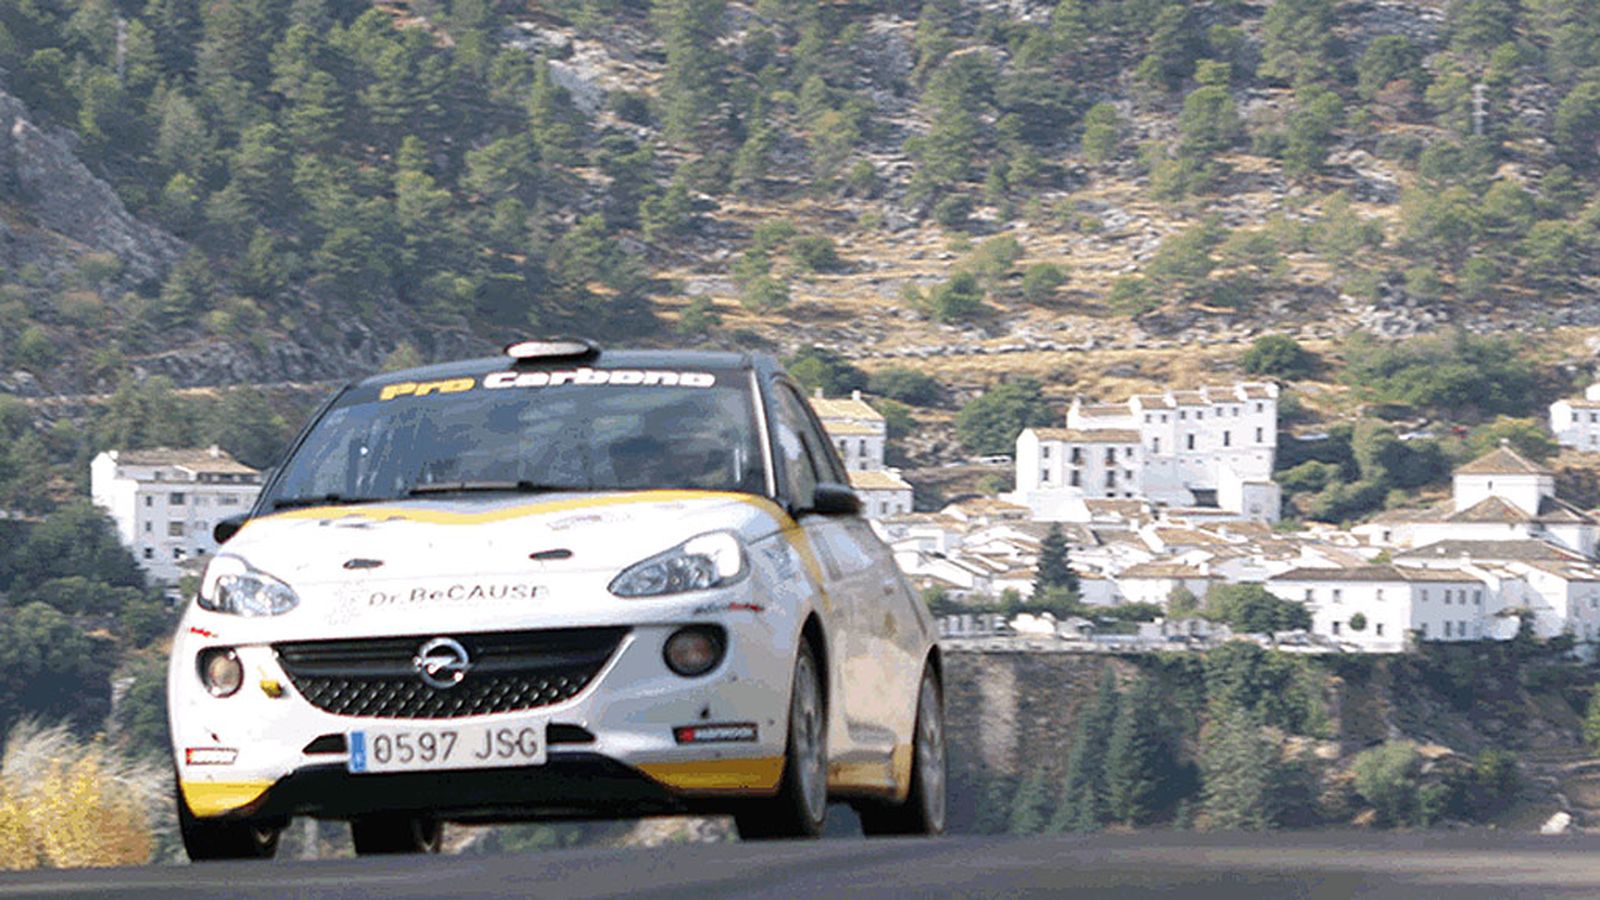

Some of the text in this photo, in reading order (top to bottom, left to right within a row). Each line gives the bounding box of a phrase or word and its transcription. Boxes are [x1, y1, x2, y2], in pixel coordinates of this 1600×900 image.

[379, 376, 476, 401] Pro
[373, 727, 538, 764] 0597 JSG
